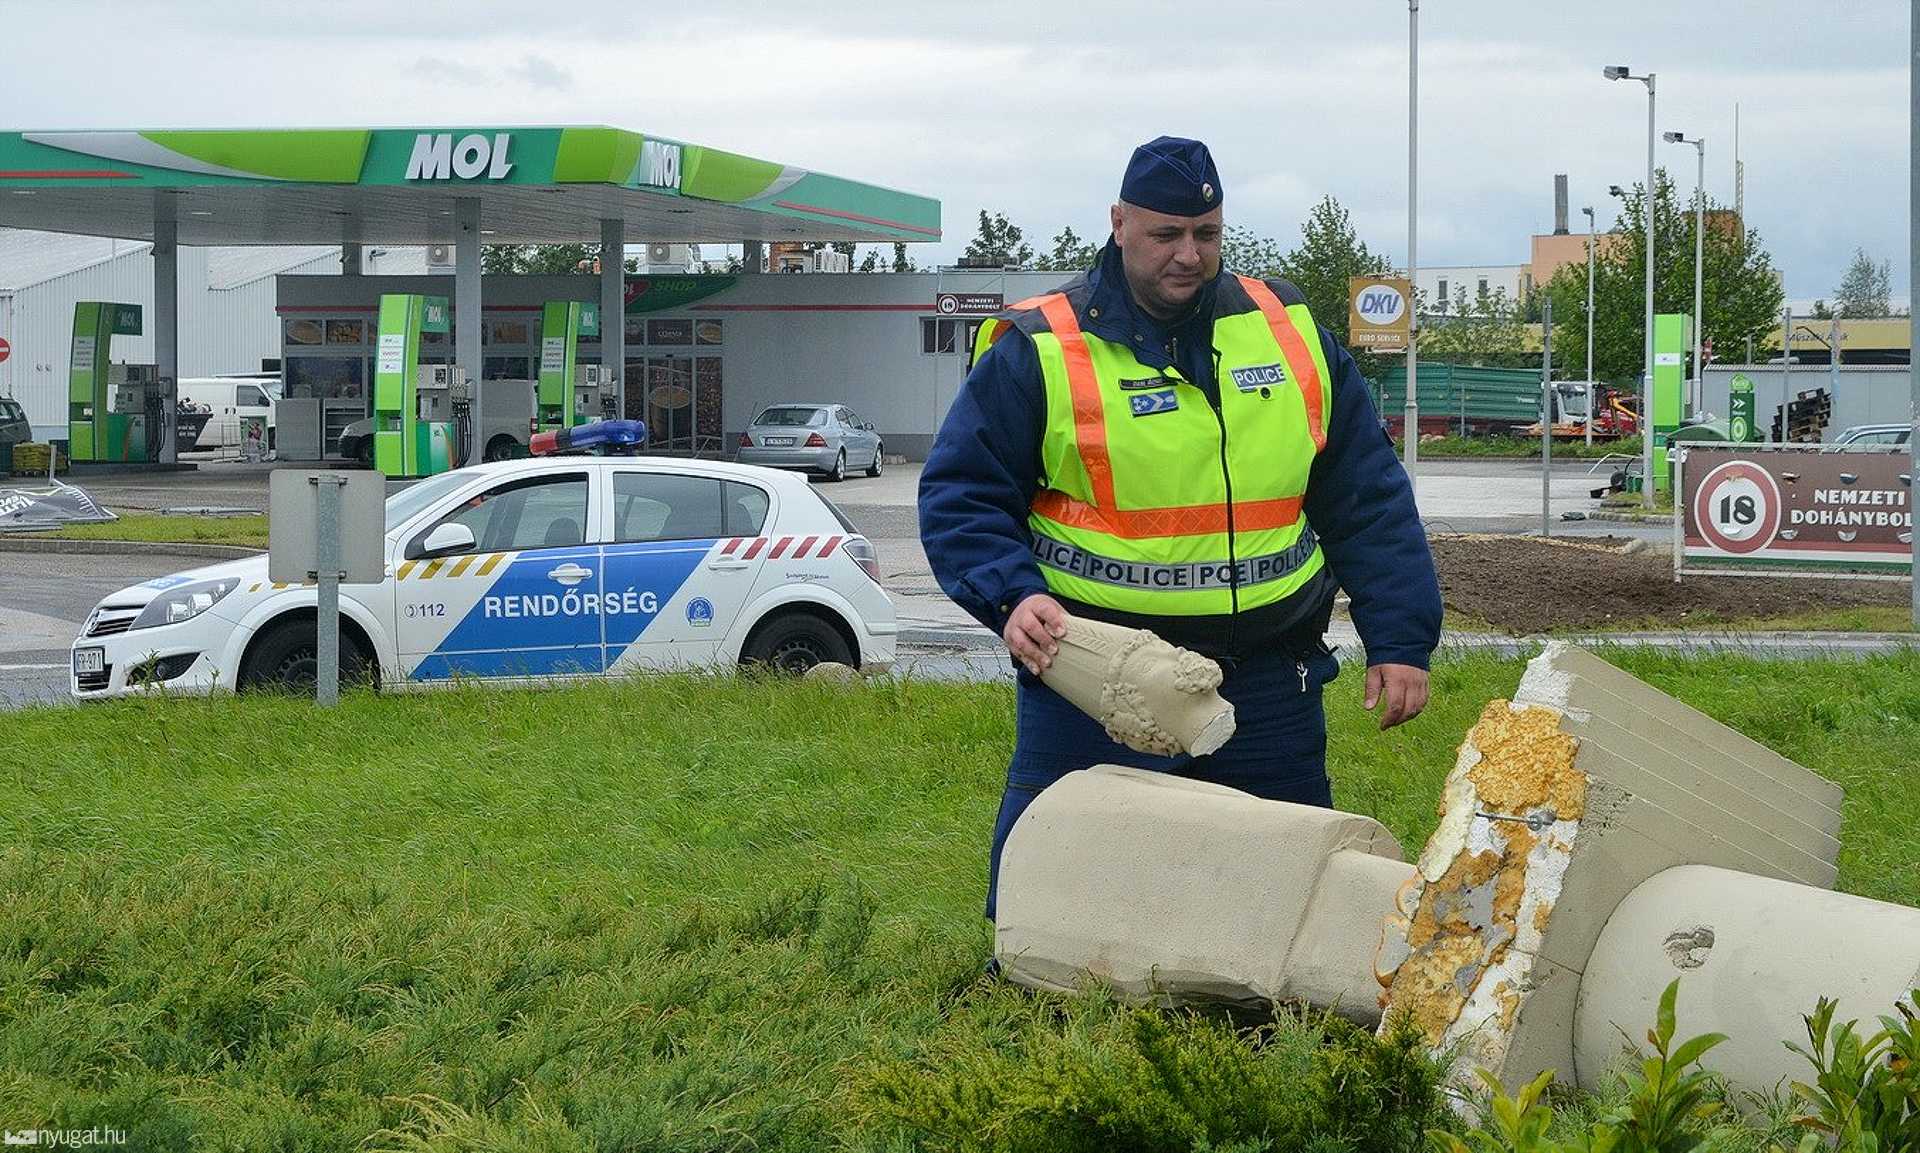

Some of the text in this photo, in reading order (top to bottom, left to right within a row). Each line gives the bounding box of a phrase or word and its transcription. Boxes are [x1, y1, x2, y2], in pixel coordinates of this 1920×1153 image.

[405, 133, 513, 180] MOL
[650, 142, 681, 189] MOL
[1361, 293, 1400, 314] DKV
[1234, 366, 1285, 385] POLICE
[1720, 494, 1756, 525] 18
[1814, 488, 1905, 506] NEMZETI
[1790, 507, 1912, 527] DOHÁNYBOL
[1034, 537, 1082, 571] LICE
[1089, 557, 1187, 587] POLICE
[421, 603, 446, 618] 112
[484, 587, 658, 618] RENDŐRSÉG
